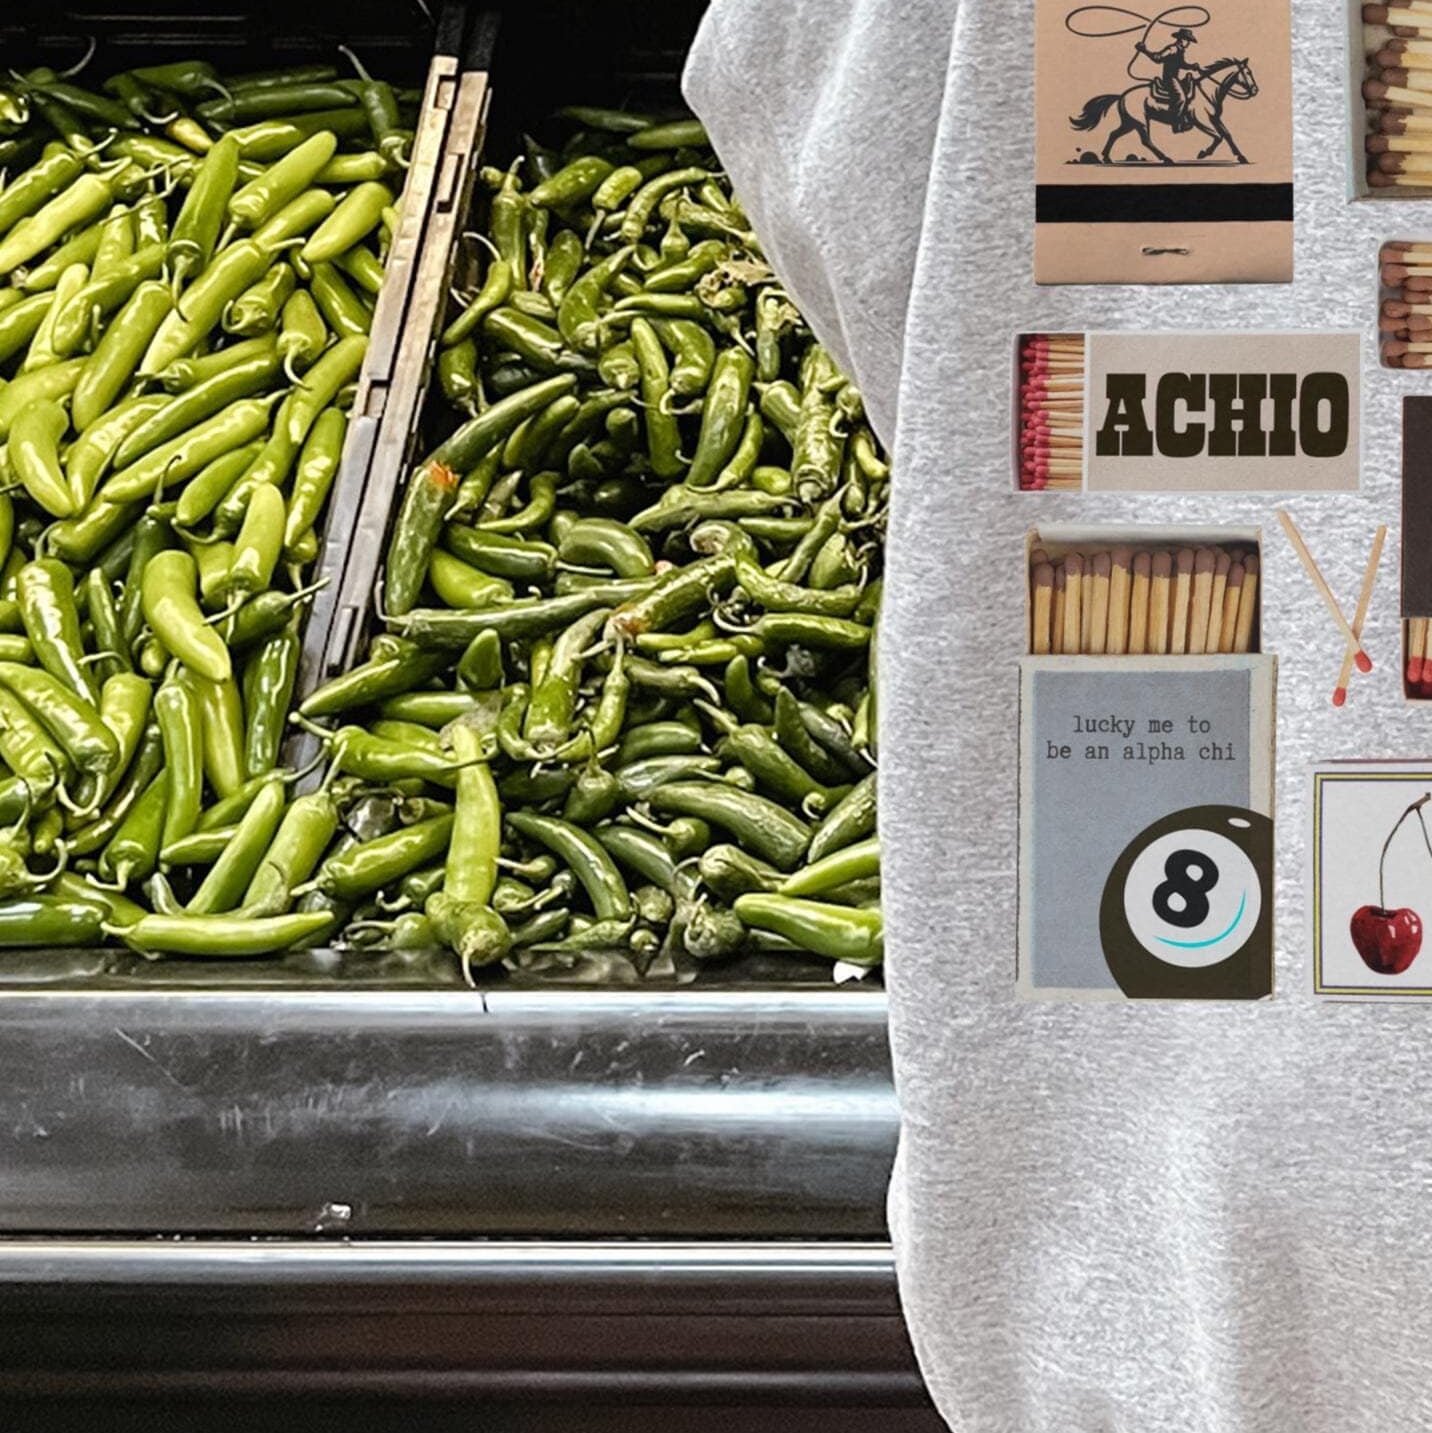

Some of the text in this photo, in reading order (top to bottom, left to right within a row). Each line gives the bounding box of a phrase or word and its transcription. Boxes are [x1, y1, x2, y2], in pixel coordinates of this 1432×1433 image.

[1095, 372, 1350, 458] ACHIO
[1046, 740, 1237, 765] be an alpha chi
[1073, 715, 1212, 739] lucky me to
[1151, 848, 1220, 929] 8
